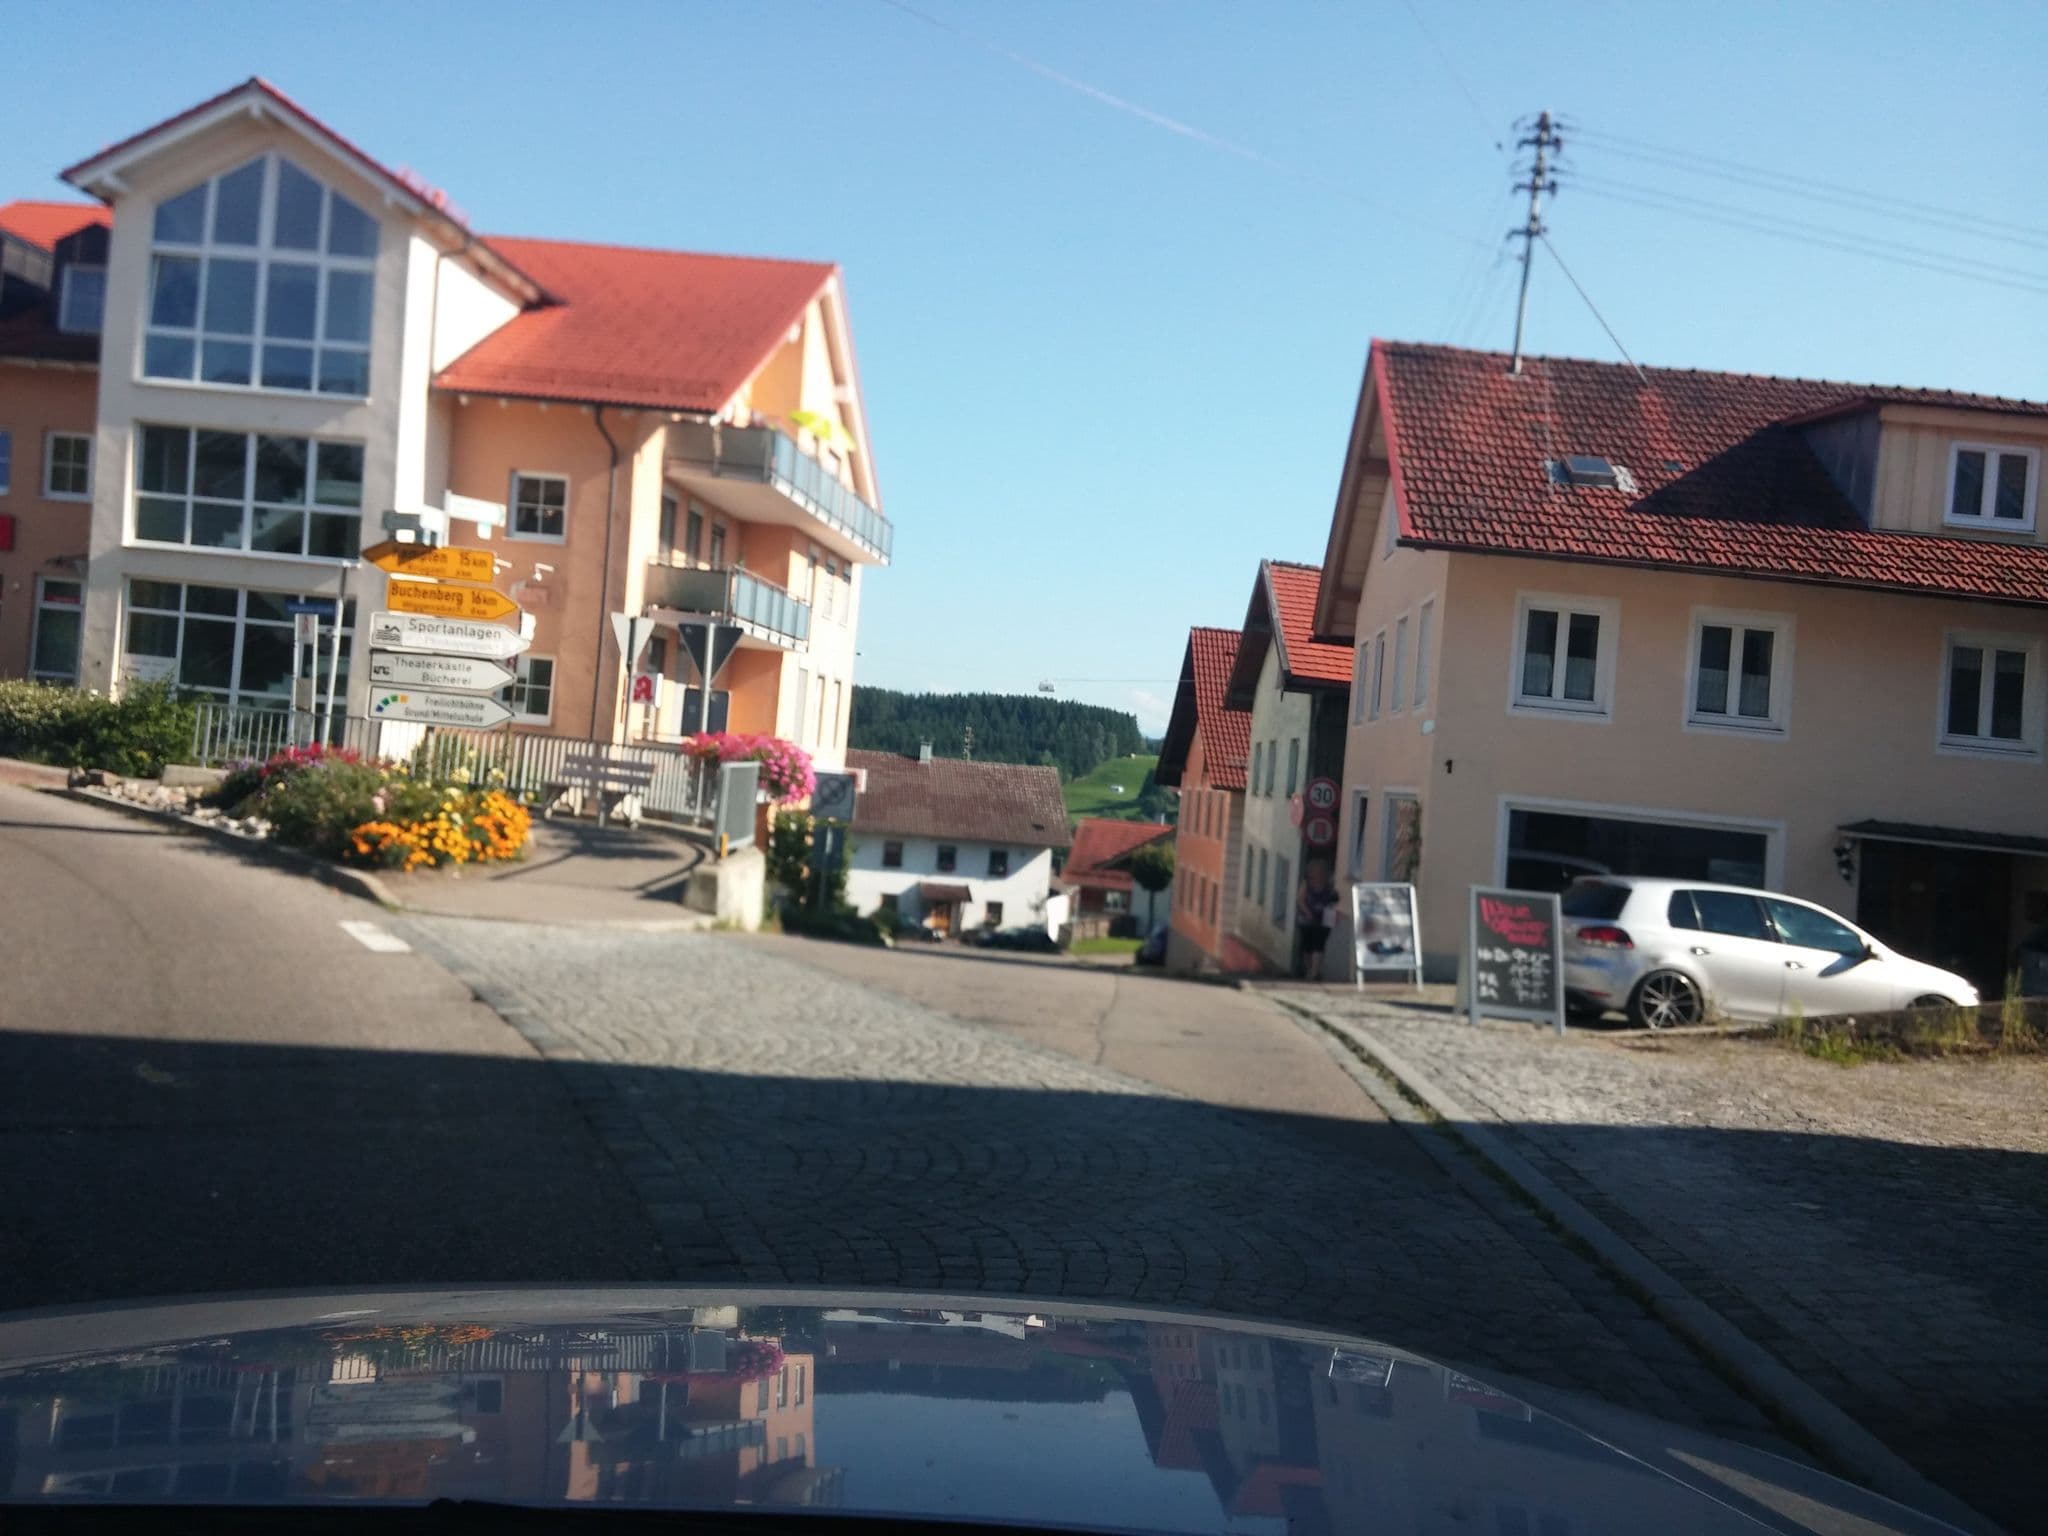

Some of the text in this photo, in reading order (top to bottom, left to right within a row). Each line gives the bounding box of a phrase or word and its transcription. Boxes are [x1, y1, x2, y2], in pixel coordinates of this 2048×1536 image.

[460, 551, 470, 566] 15
[391, 585, 463, 605] Buchenberg
[471, 590, 481, 603] 16
[408, 618, 501, 640] Sportanlagen
[1445, 759, 1453, 774] 1
[1314, 787, 1333, 802] 30
